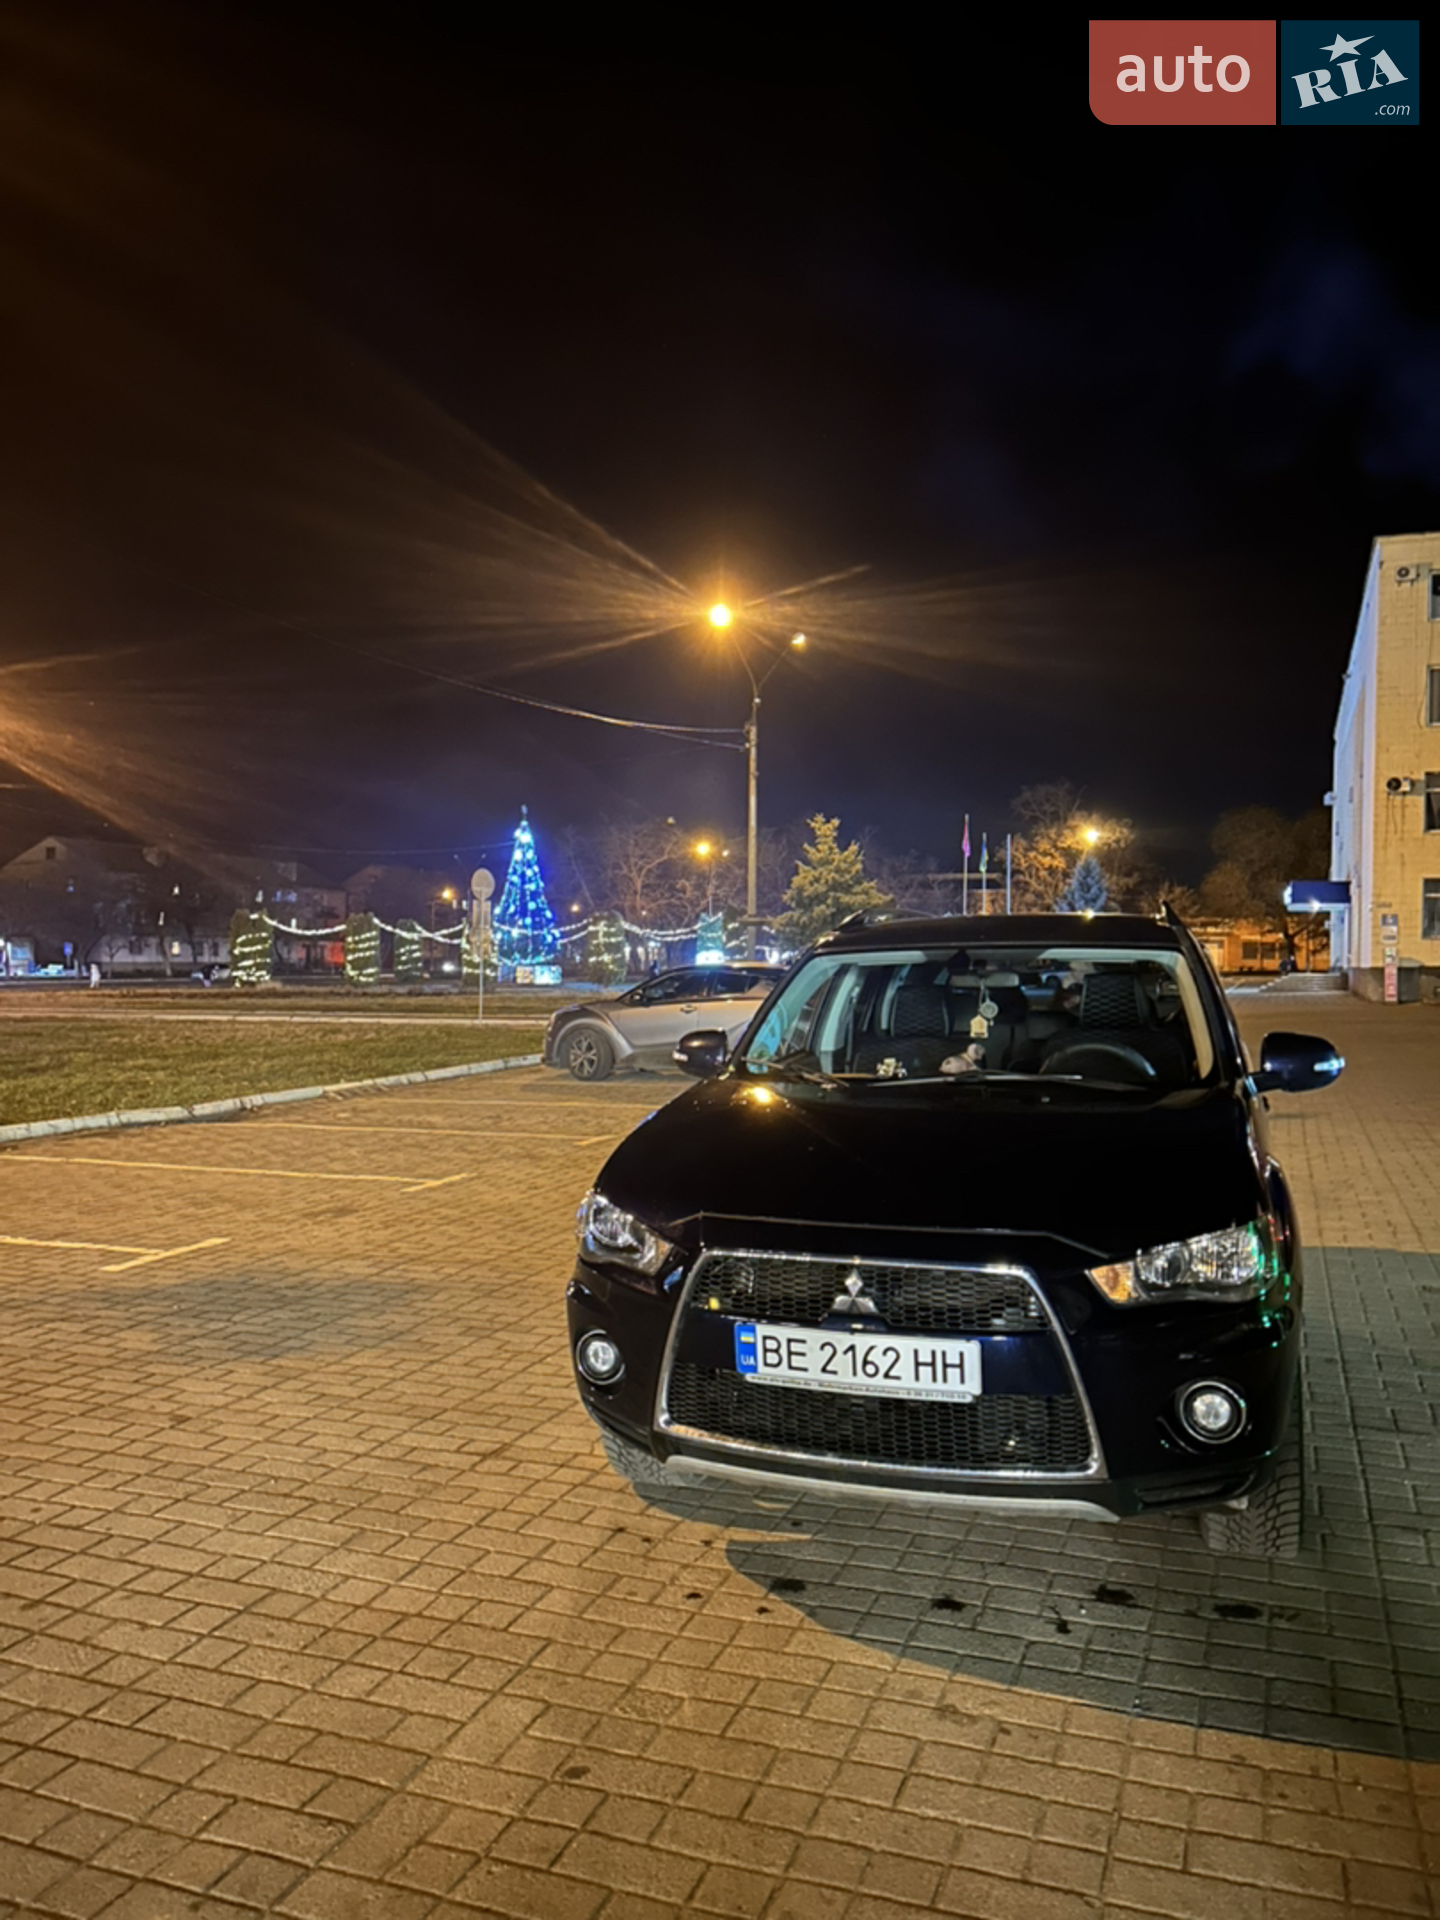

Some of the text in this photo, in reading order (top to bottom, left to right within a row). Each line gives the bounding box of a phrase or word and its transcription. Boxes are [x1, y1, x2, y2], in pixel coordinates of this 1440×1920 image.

[741, 1354, 756, 1366] UA
[762, 1335, 966, 1385] BE 2162 HH
